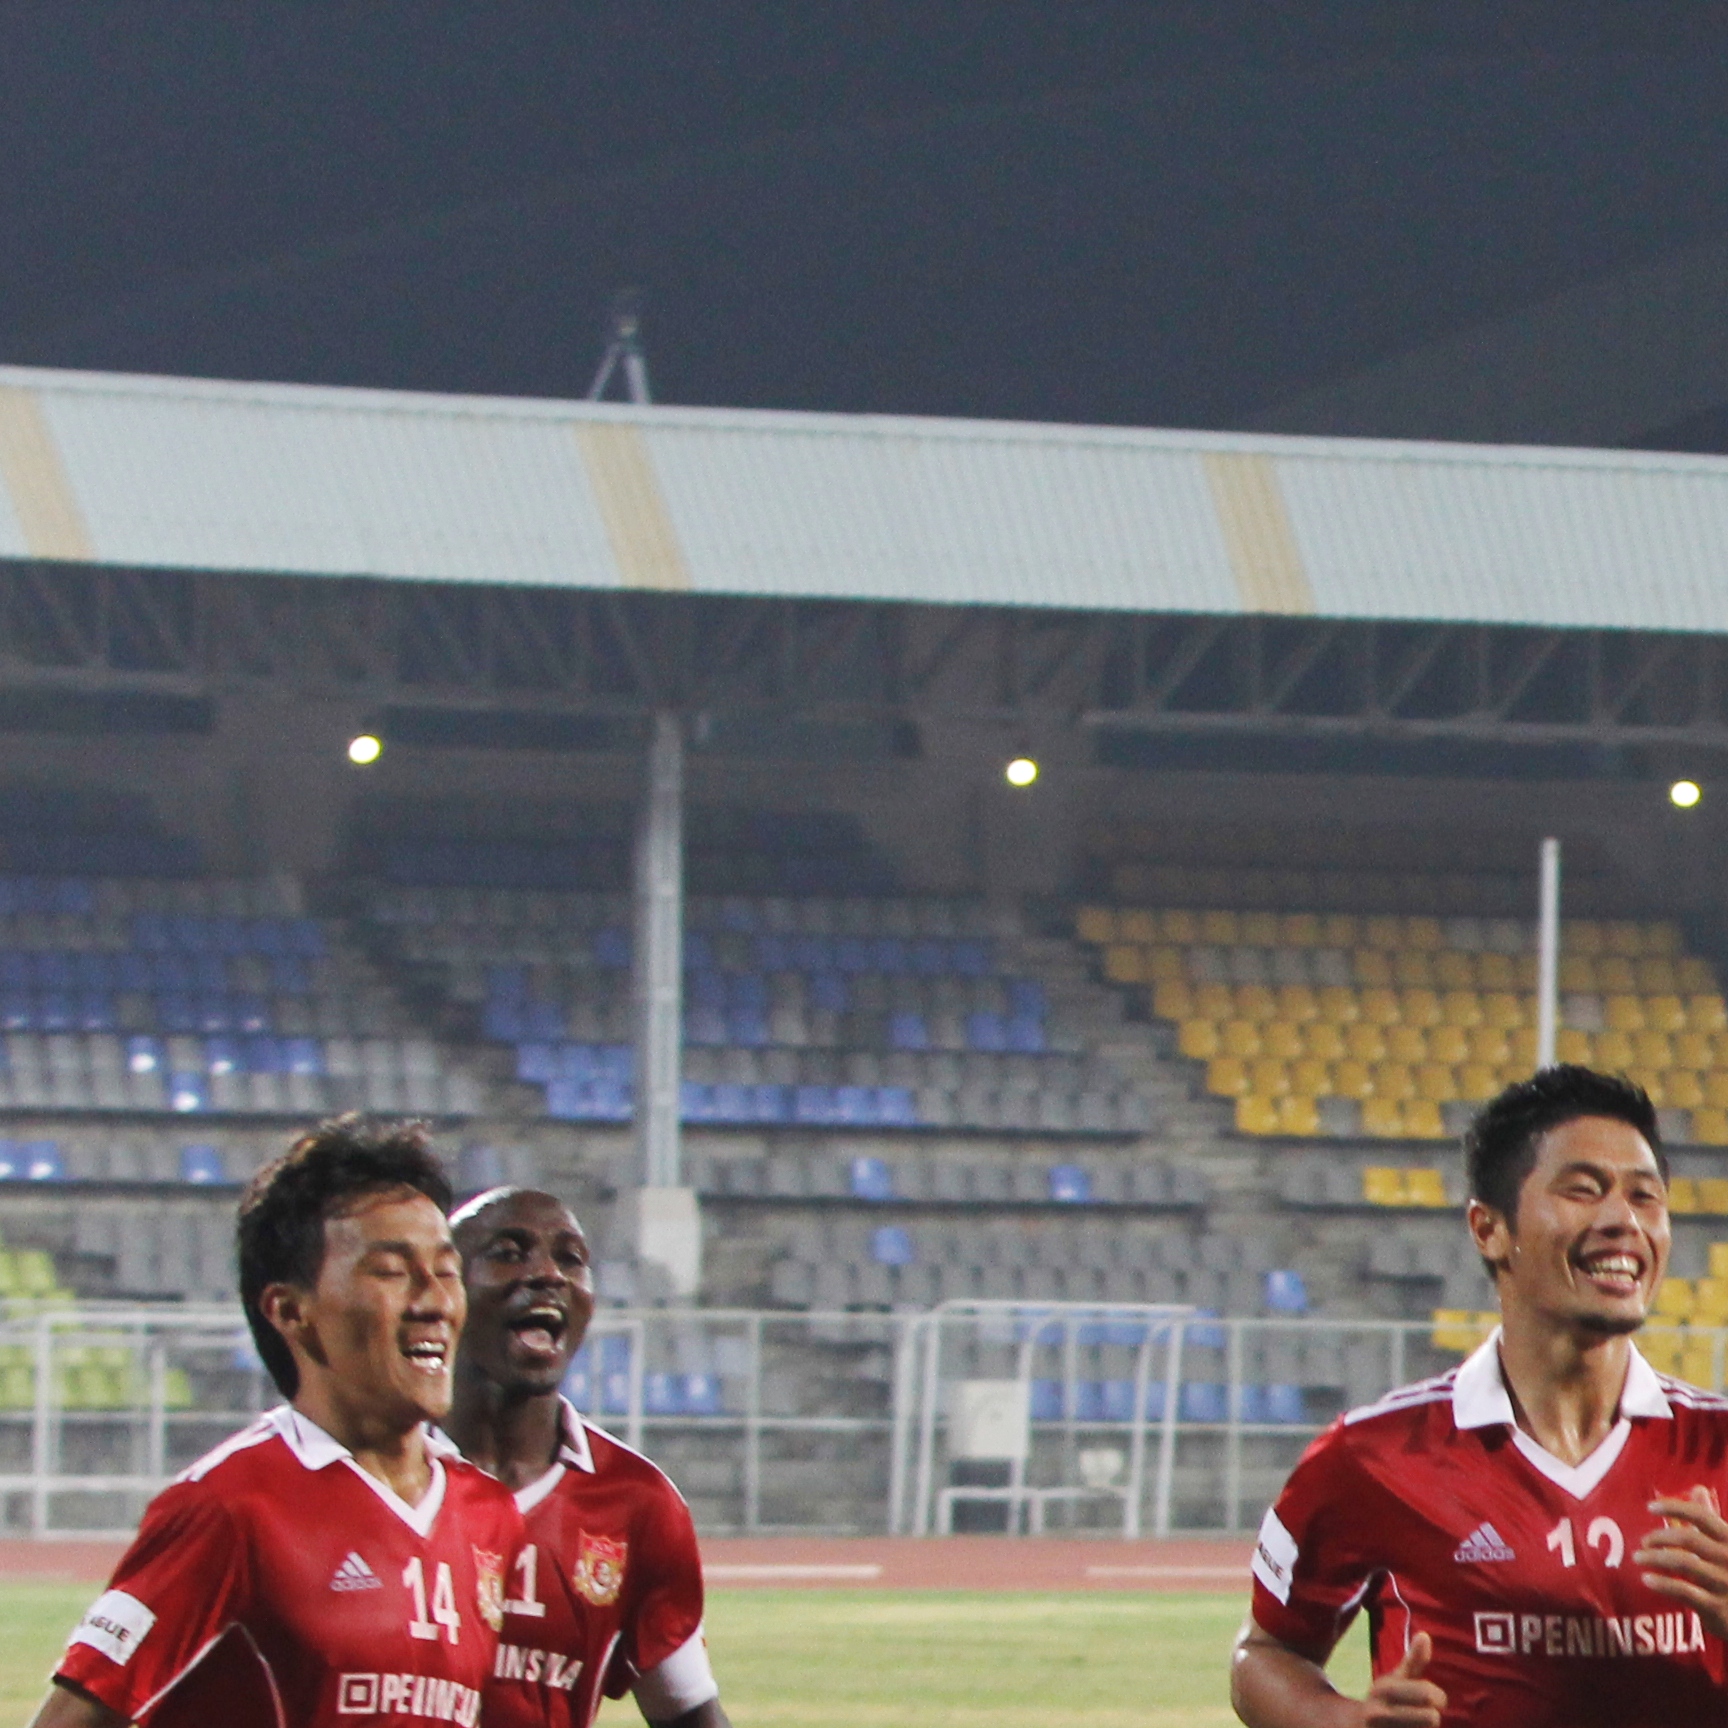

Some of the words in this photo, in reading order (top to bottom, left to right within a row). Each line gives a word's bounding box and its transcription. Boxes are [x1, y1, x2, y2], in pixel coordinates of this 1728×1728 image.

[401, 1555, 461, 1646] 14
[500, 1543, 548, 1619] 1
[1520, 1610, 1706, 1657] PENINSULA
